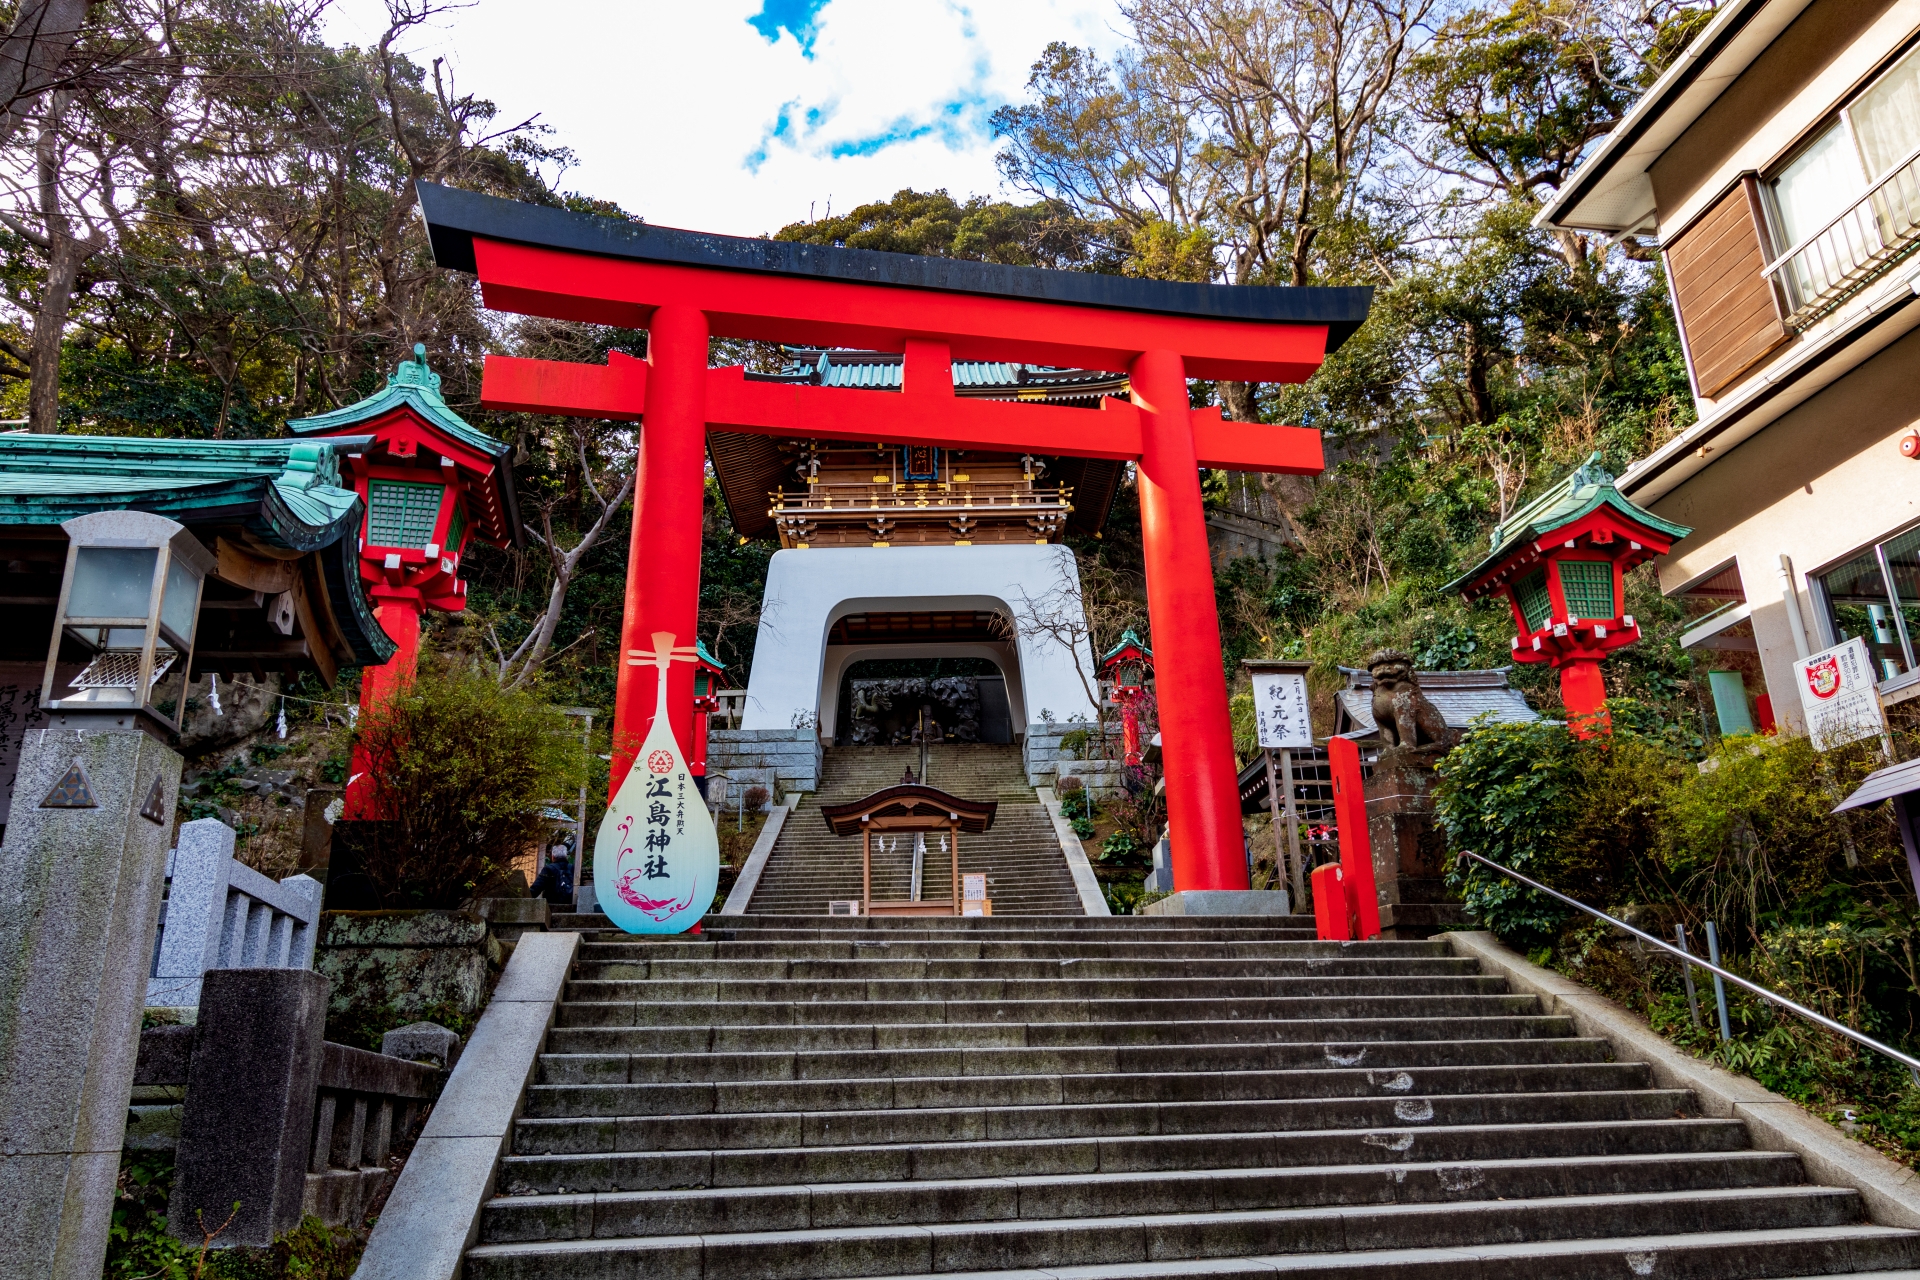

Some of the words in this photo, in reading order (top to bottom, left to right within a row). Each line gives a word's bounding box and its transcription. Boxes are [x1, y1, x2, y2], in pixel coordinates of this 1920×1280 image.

[1268, 684, 1291, 740] 紀元祭
[1293, 679, 1304, 713] 二月十一日
[1298, 718, 1307, 739] 十一時
[643, 773, 673, 880] 江島神社
